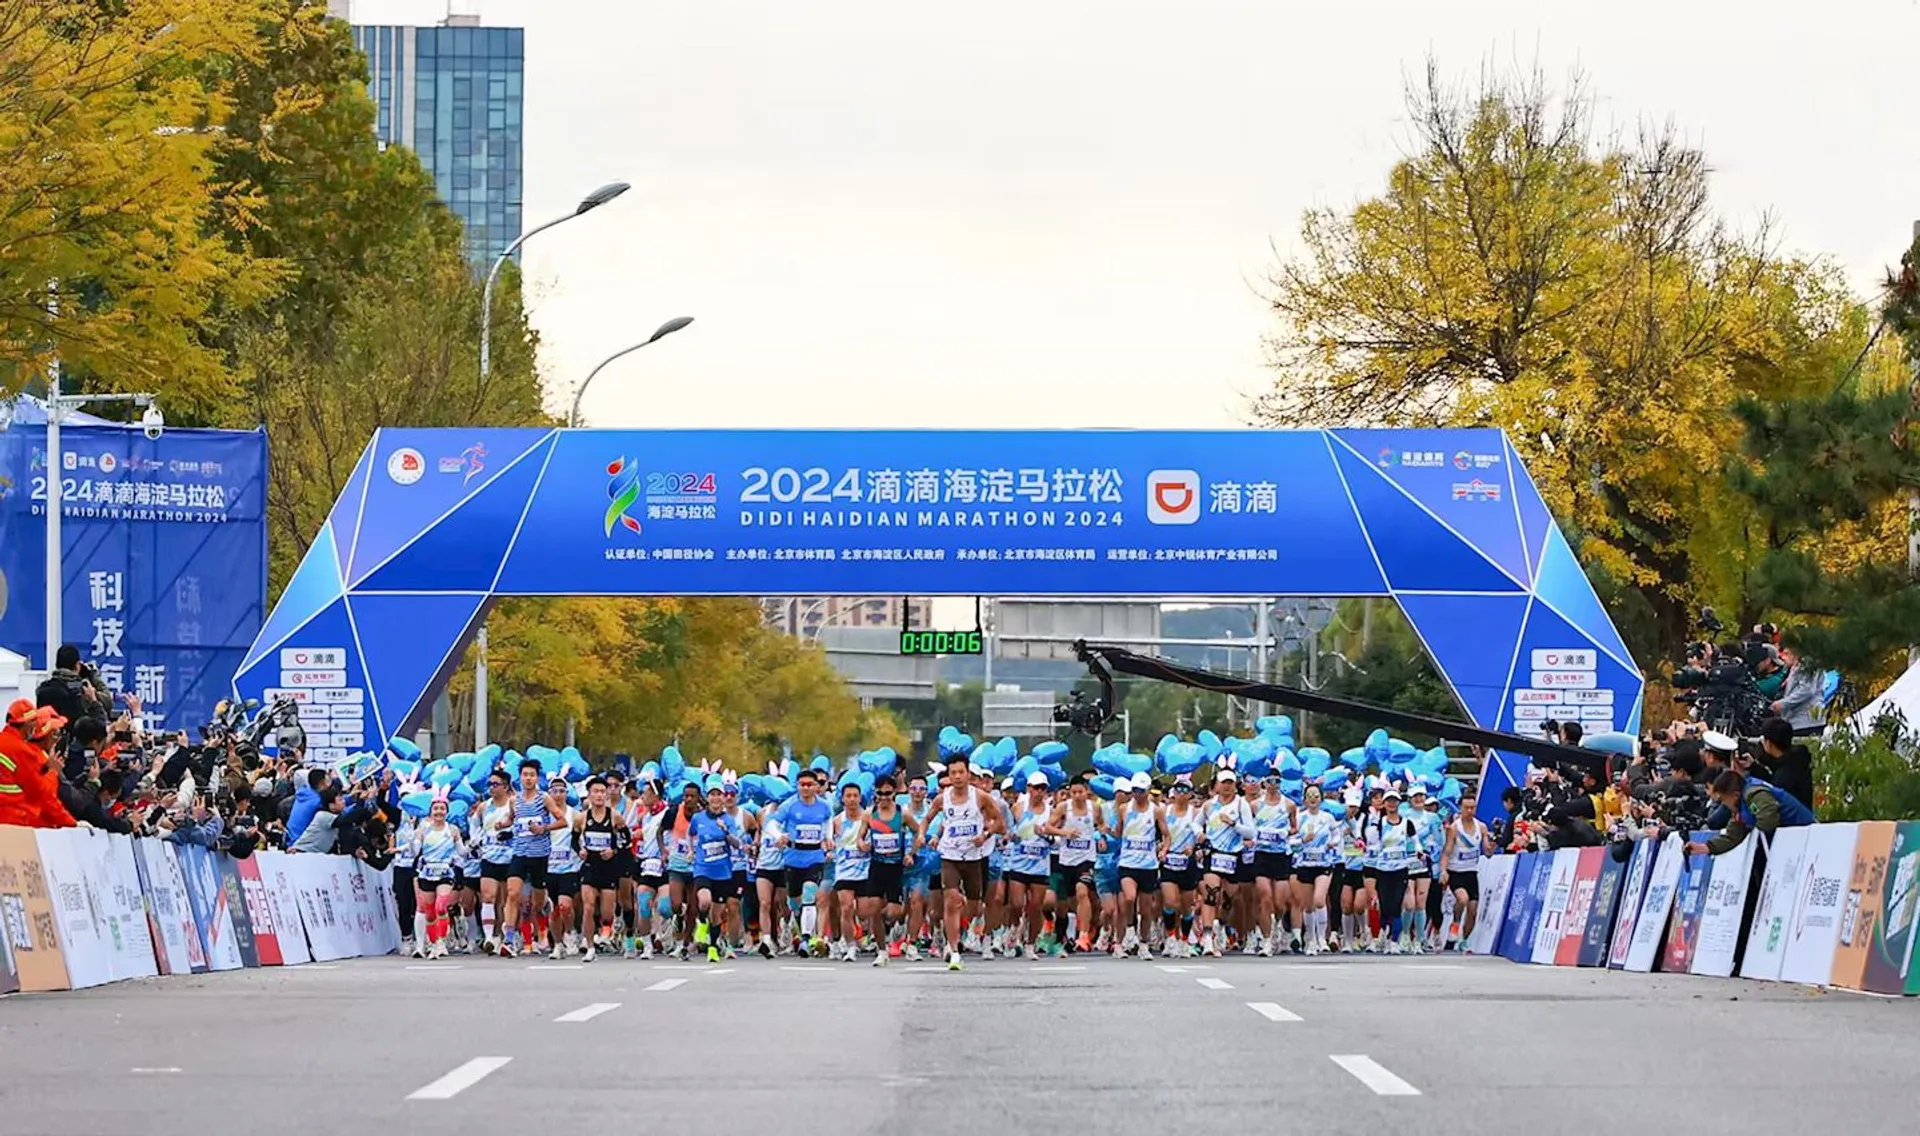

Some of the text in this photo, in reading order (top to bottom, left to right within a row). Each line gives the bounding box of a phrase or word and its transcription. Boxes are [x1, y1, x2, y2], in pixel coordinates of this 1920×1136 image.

[31, 477, 225, 508] 224滴滴海淀马拉松
[646, 473, 717, 494] 2024
[739, 467, 1124, 504] 2024滴滴海淀马拉松
[1209, 480, 1278, 513] 滴滴
[122, 509, 193, 521] MARATHON
[196, 512, 228, 523] 2024
[647, 505, 717, 520] 海淀马拉松
[740, 512, 1123, 527] DIDI HAIDIAN MARATHON 2024
[902, 633, 980, 653] 0:00:06
